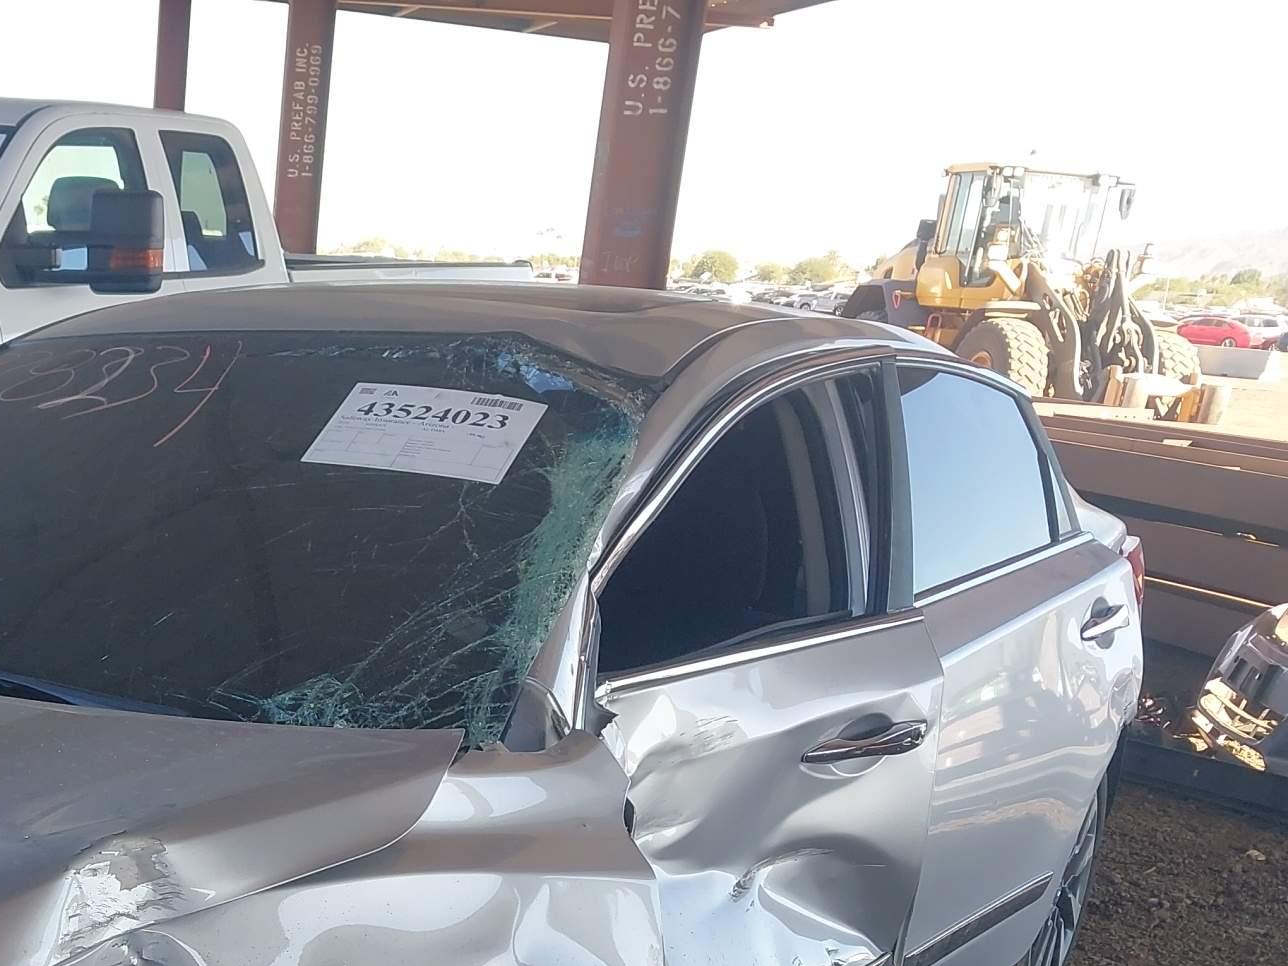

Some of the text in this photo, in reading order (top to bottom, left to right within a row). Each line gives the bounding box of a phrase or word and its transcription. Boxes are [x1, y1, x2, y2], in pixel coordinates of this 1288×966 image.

[287, 42, 310, 178] U.S. PREFAB INC.
[623, 65, 650, 116] U.S.
[356, 400, 510, 430] 43524023
